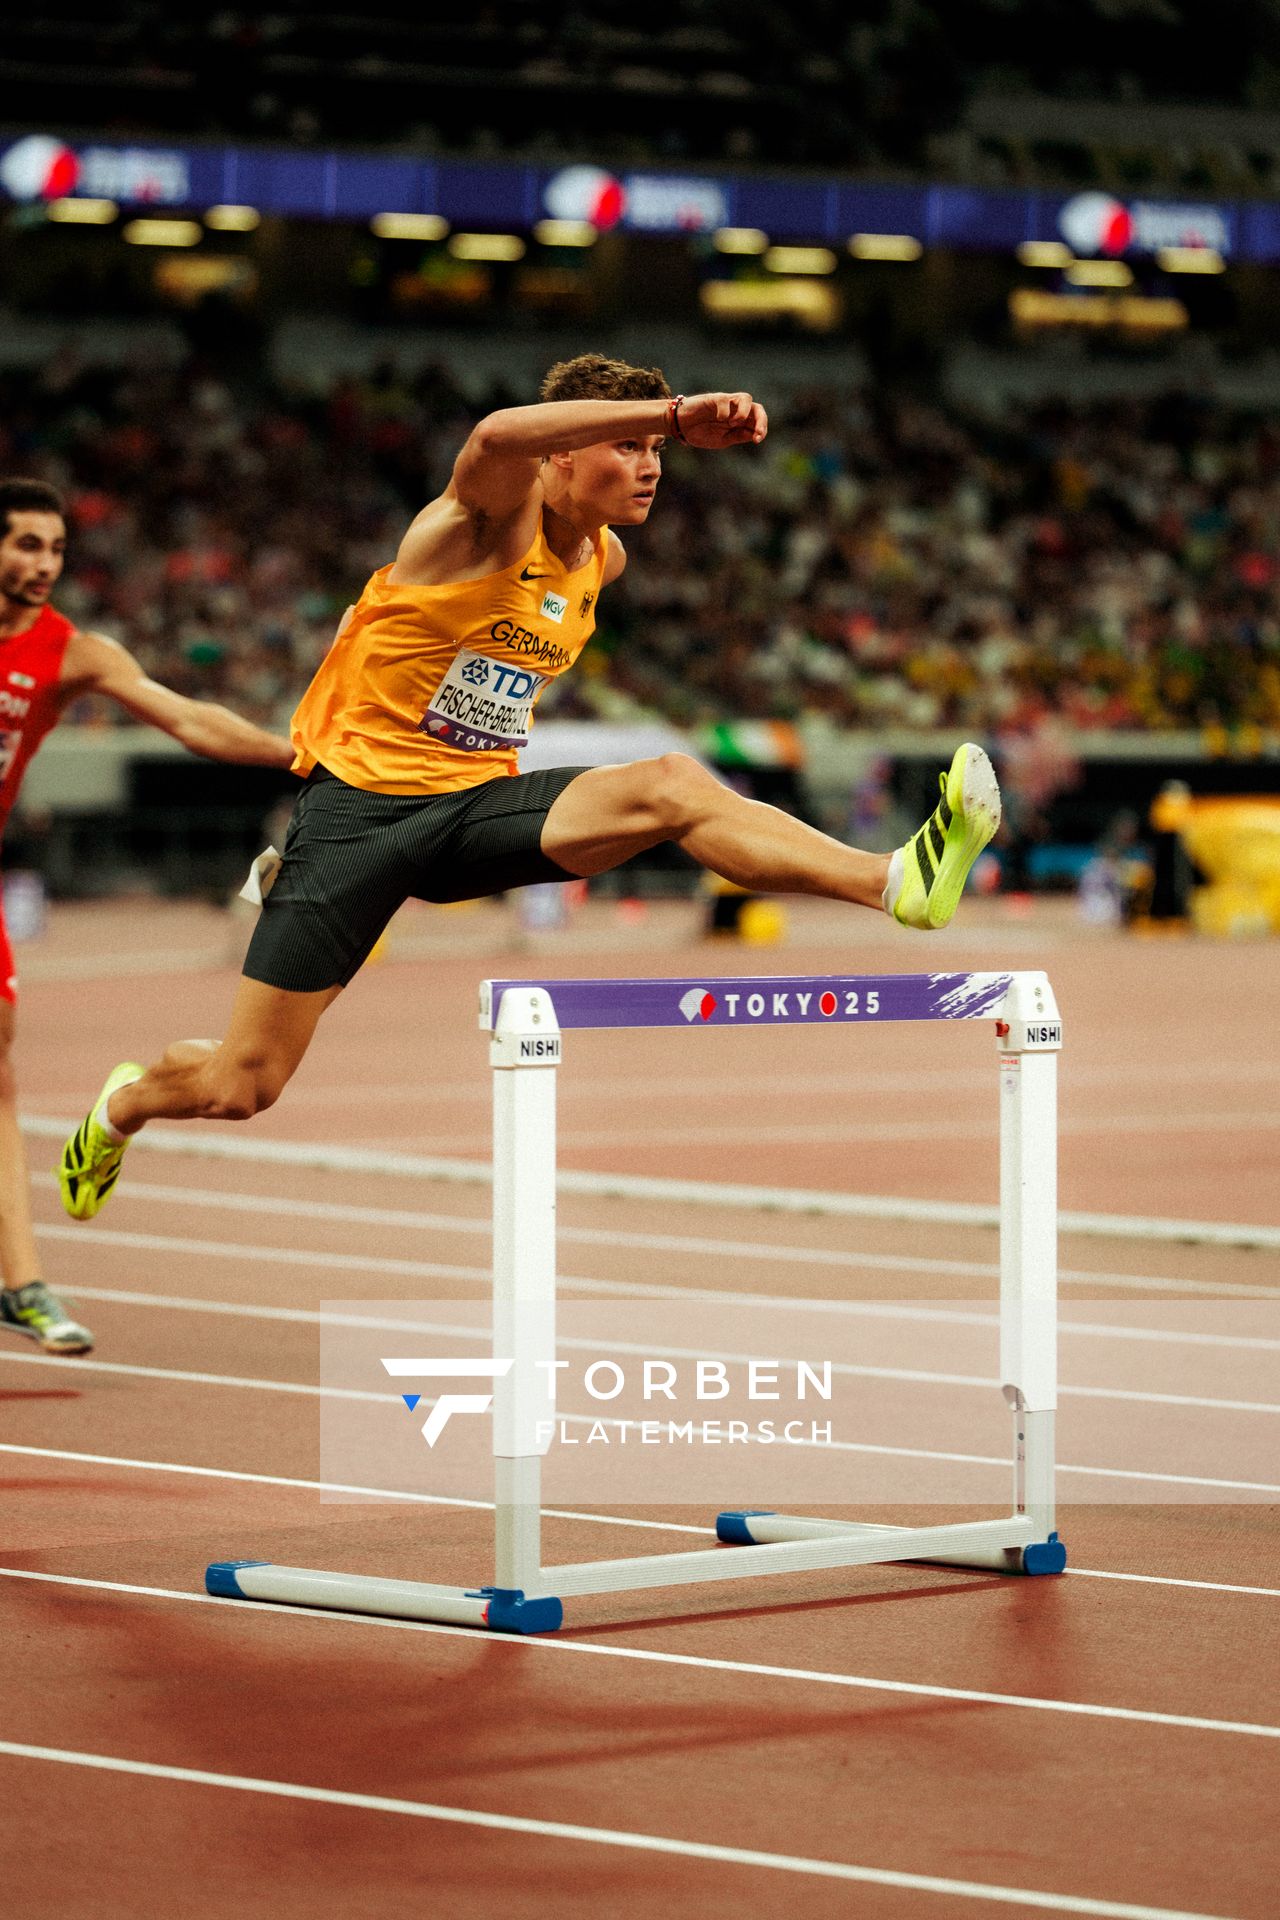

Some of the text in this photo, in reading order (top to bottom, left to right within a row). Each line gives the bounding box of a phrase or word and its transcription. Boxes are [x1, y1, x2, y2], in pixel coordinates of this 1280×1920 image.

[543, 597, 564, 615] WGV
[492, 664, 546, 700] TDK
[1027, 1027, 1060, 1043] NISHI
[521, 1041, 559, 1056] NISHI
